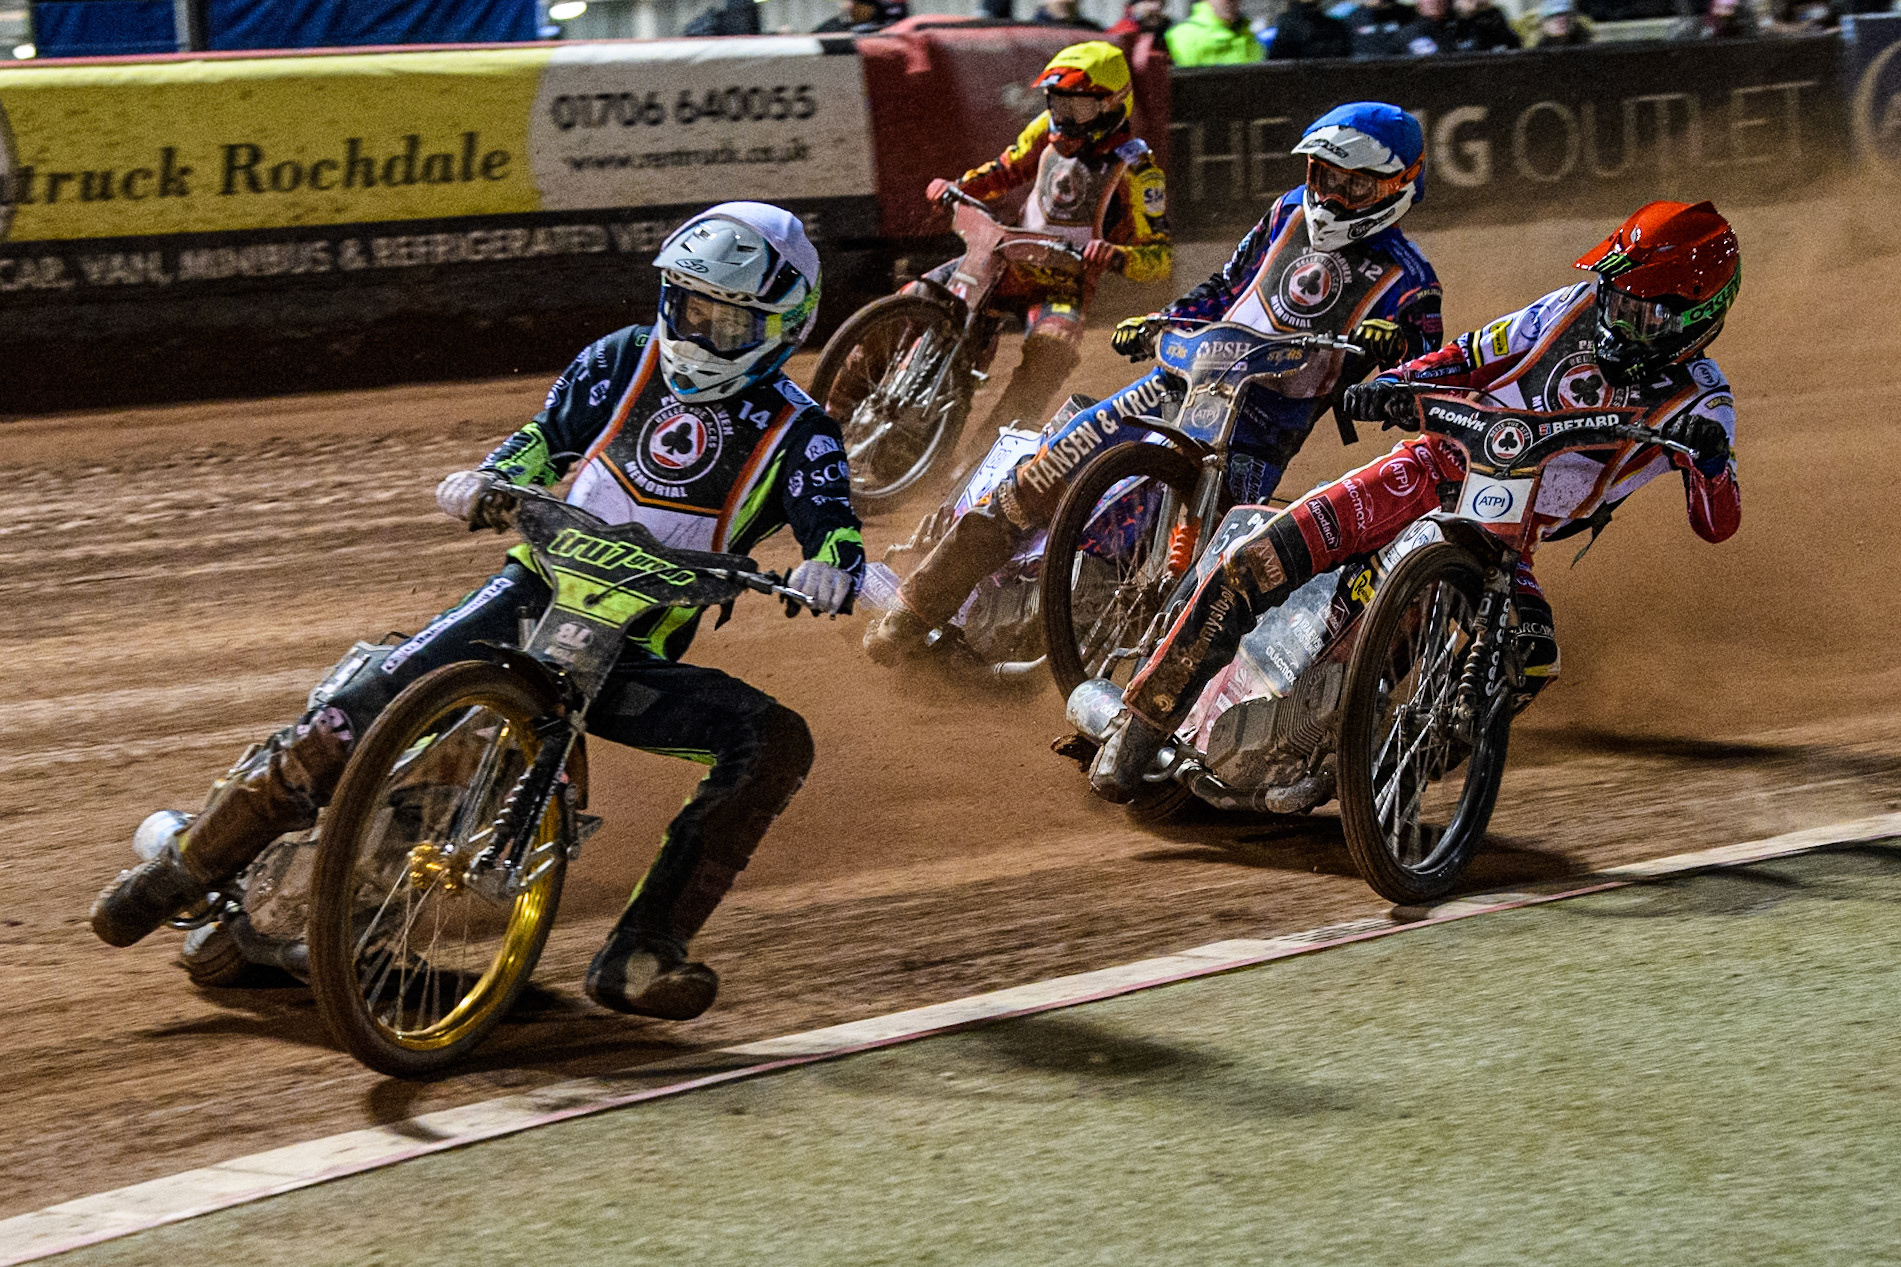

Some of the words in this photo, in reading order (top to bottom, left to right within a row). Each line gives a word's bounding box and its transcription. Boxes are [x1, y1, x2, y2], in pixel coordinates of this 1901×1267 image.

[0, 146, 195, 205] truck
[217, 131, 512, 196] Rochdale
[1358, 257, 1384, 283] 12
[1270, 295, 1312, 329] MEMORIAL
[738, 400, 772, 431] 14
[1551, 413, 1620, 434] BETARD
[1023, 420, 1103, 494] HANSEN
[1095, 409, 1120, 435] &
[624, 460, 689, 499] MEMORIAL
[1389, 462, 1410, 489] ATPI
[1477, 495, 1506, 508] ATPI
[1308, 498, 1336, 545] Alpodach
